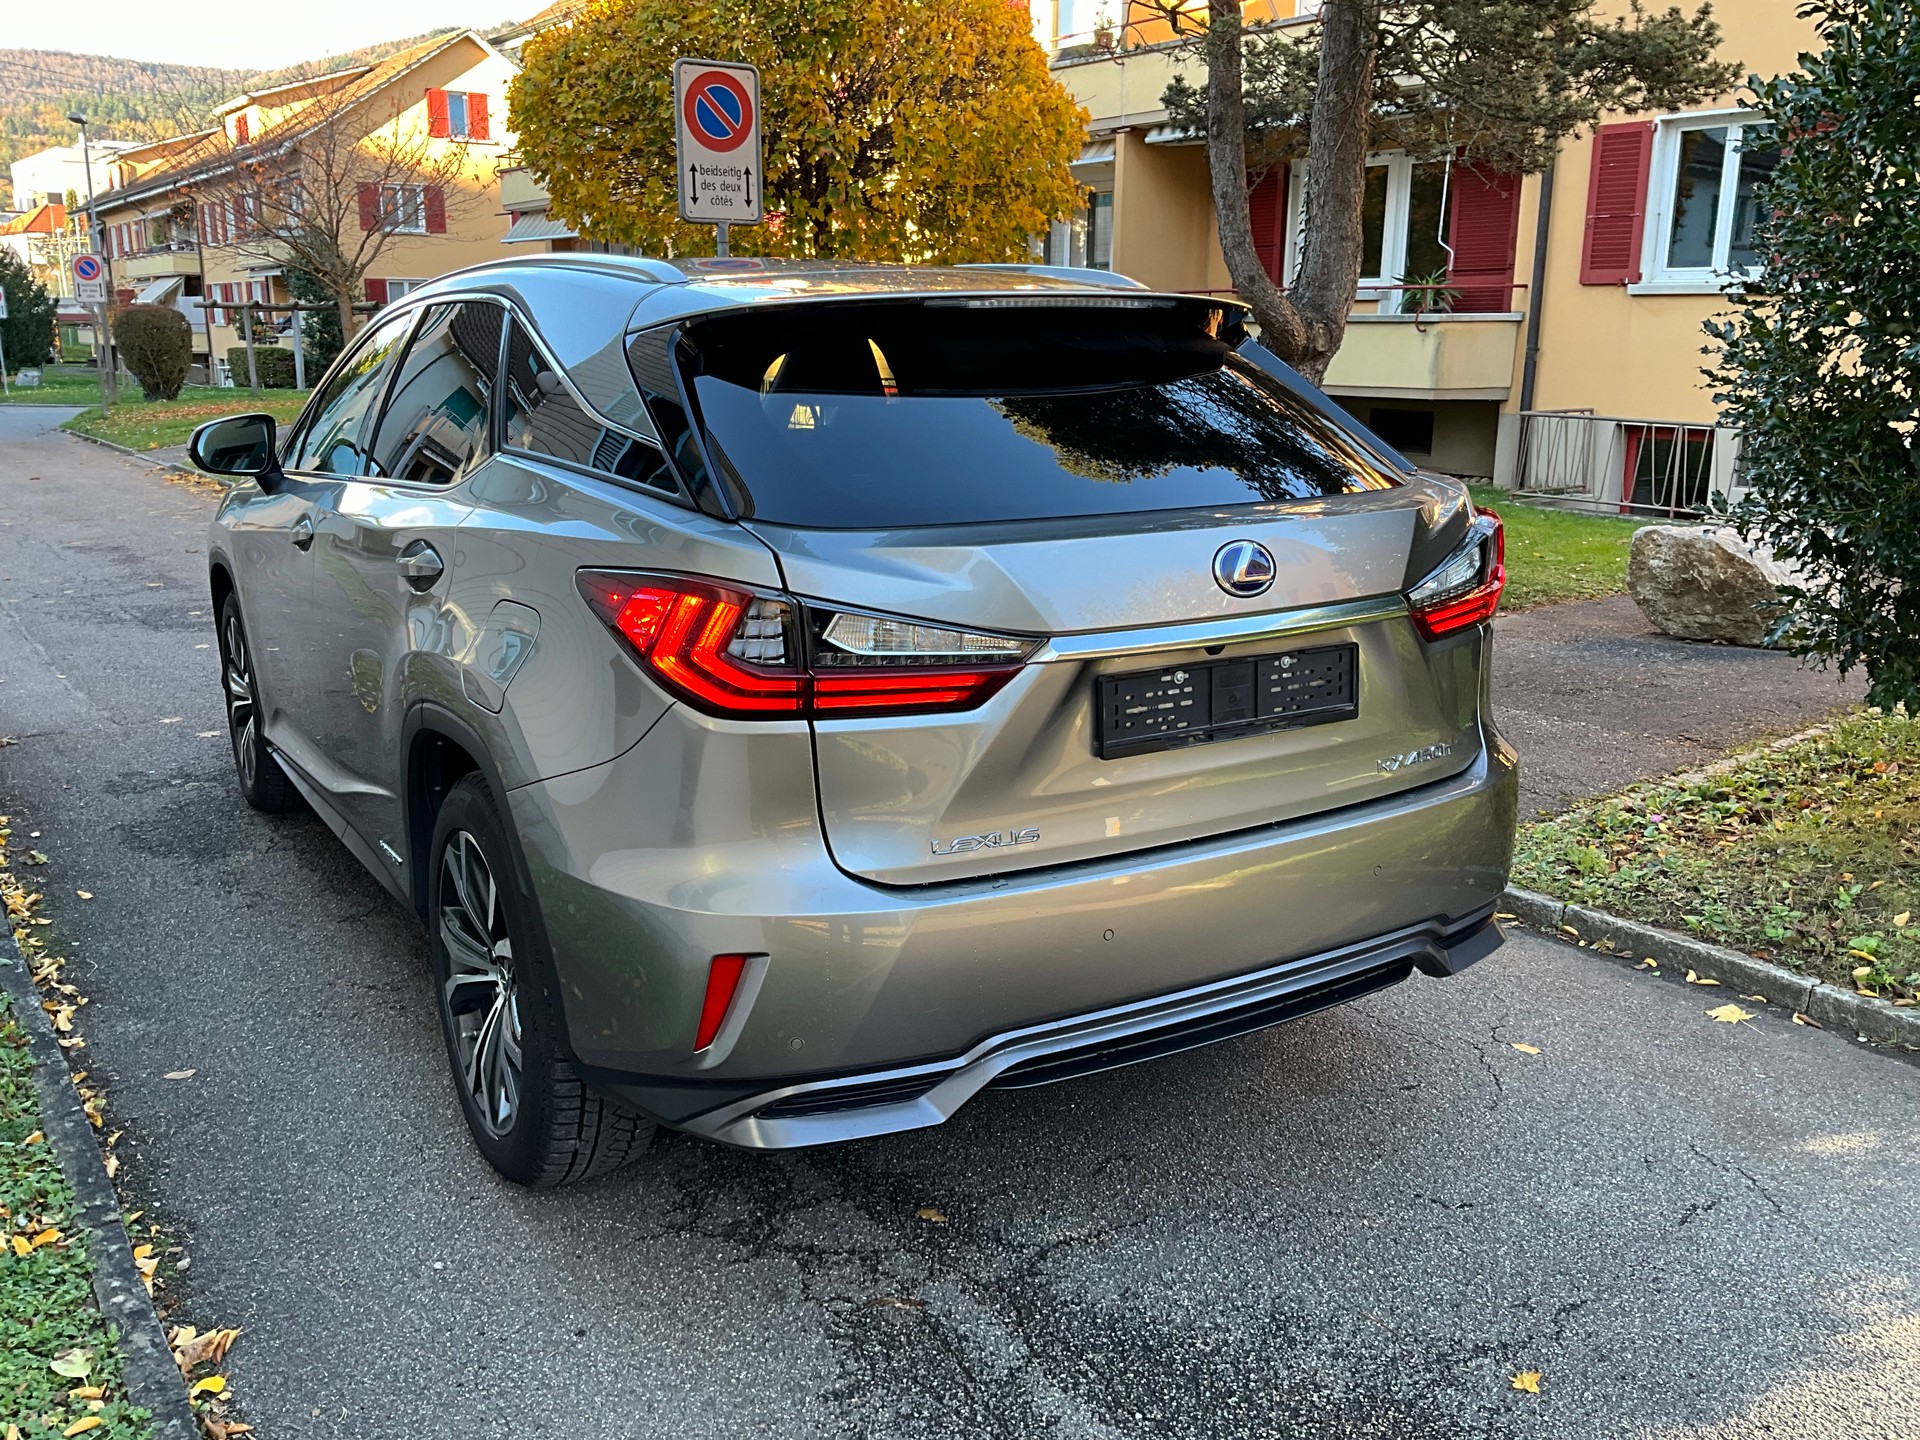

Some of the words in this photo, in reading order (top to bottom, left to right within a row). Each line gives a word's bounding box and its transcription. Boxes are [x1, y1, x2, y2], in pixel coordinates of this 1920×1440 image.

[699, 164, 742, 180] beidseitig
[700, 179, 717, 191] des
[719, 180, 742, 192] deux
[710, 194, 734, 207] côtés
[931, 827, 1041, 856] LEXUS
